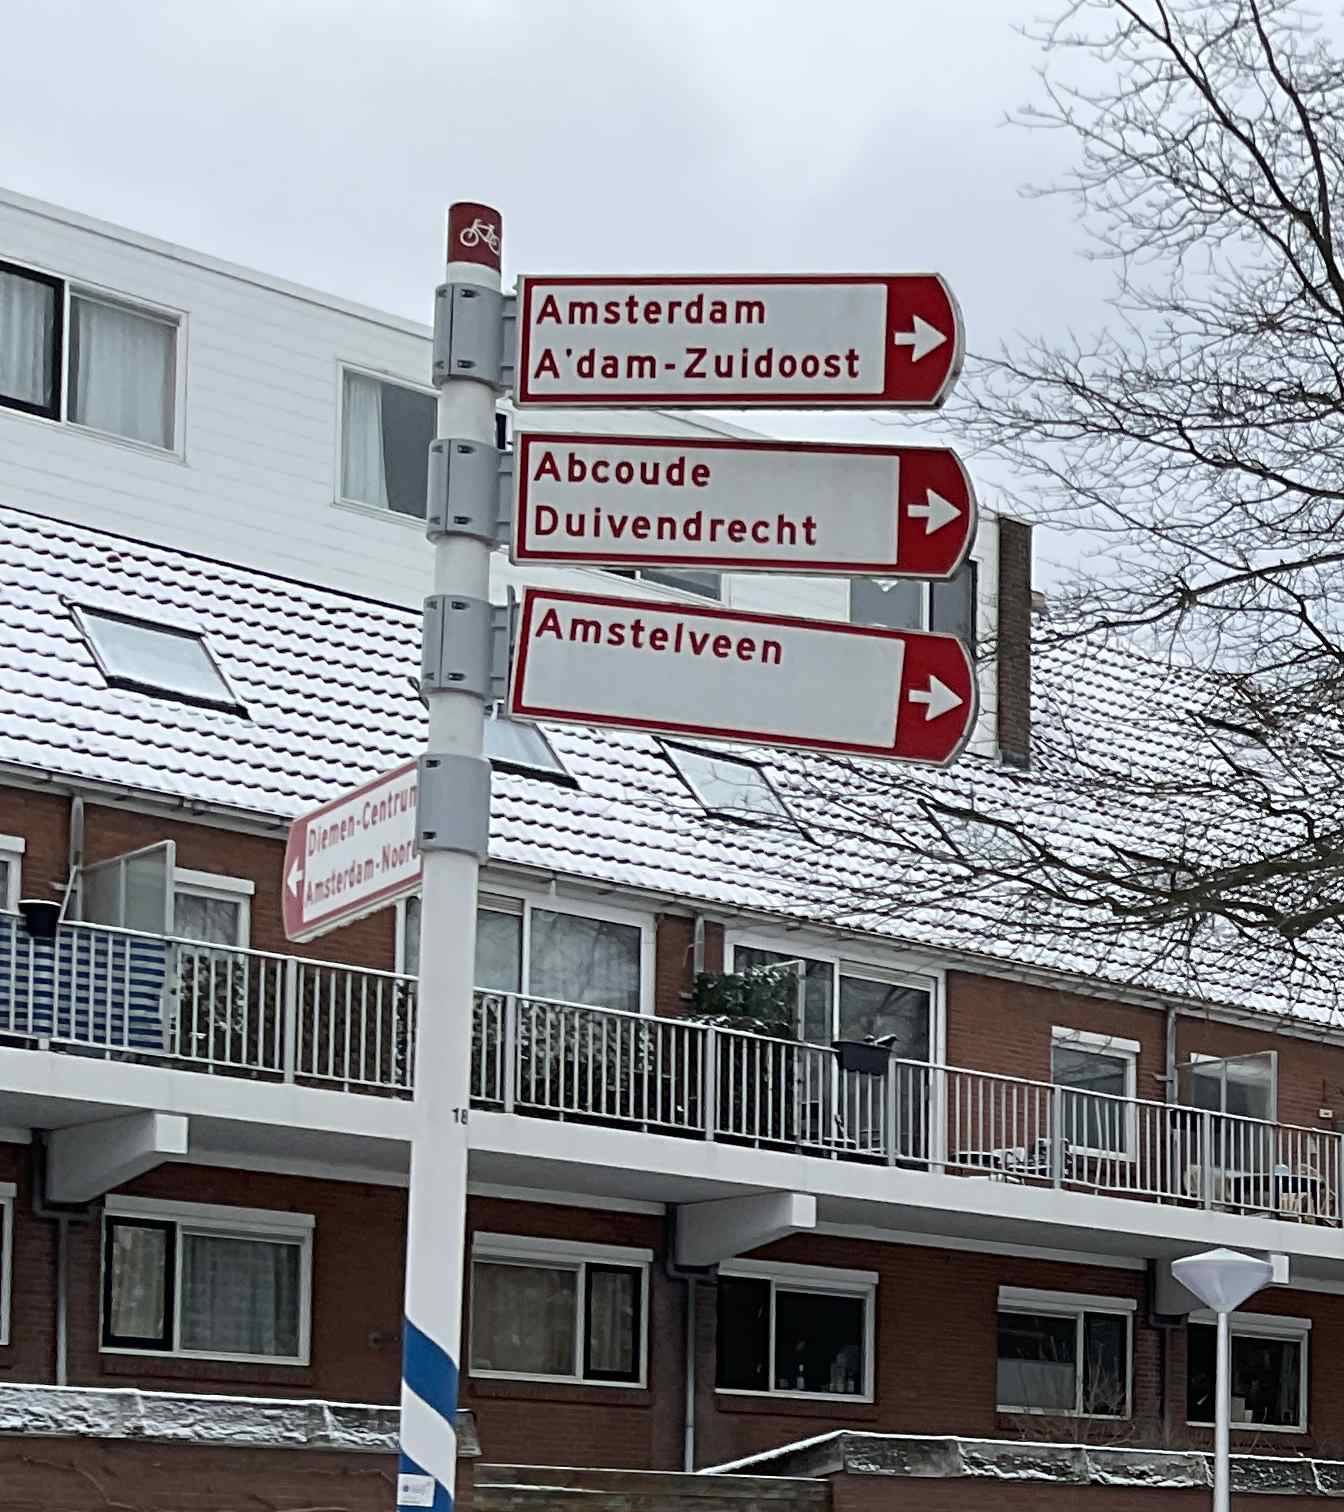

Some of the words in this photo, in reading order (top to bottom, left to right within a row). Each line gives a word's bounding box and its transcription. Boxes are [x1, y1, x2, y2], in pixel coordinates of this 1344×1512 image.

[537, 294, 765, 324] Amsterdam
[534, 347, 860, 379] A'dam-Zuidoost
[534, 452, 711, 487] Abcoude
[535, 506, 817, 545] Duivendrecht
[536, 608, 782, 664] Amstelveen
